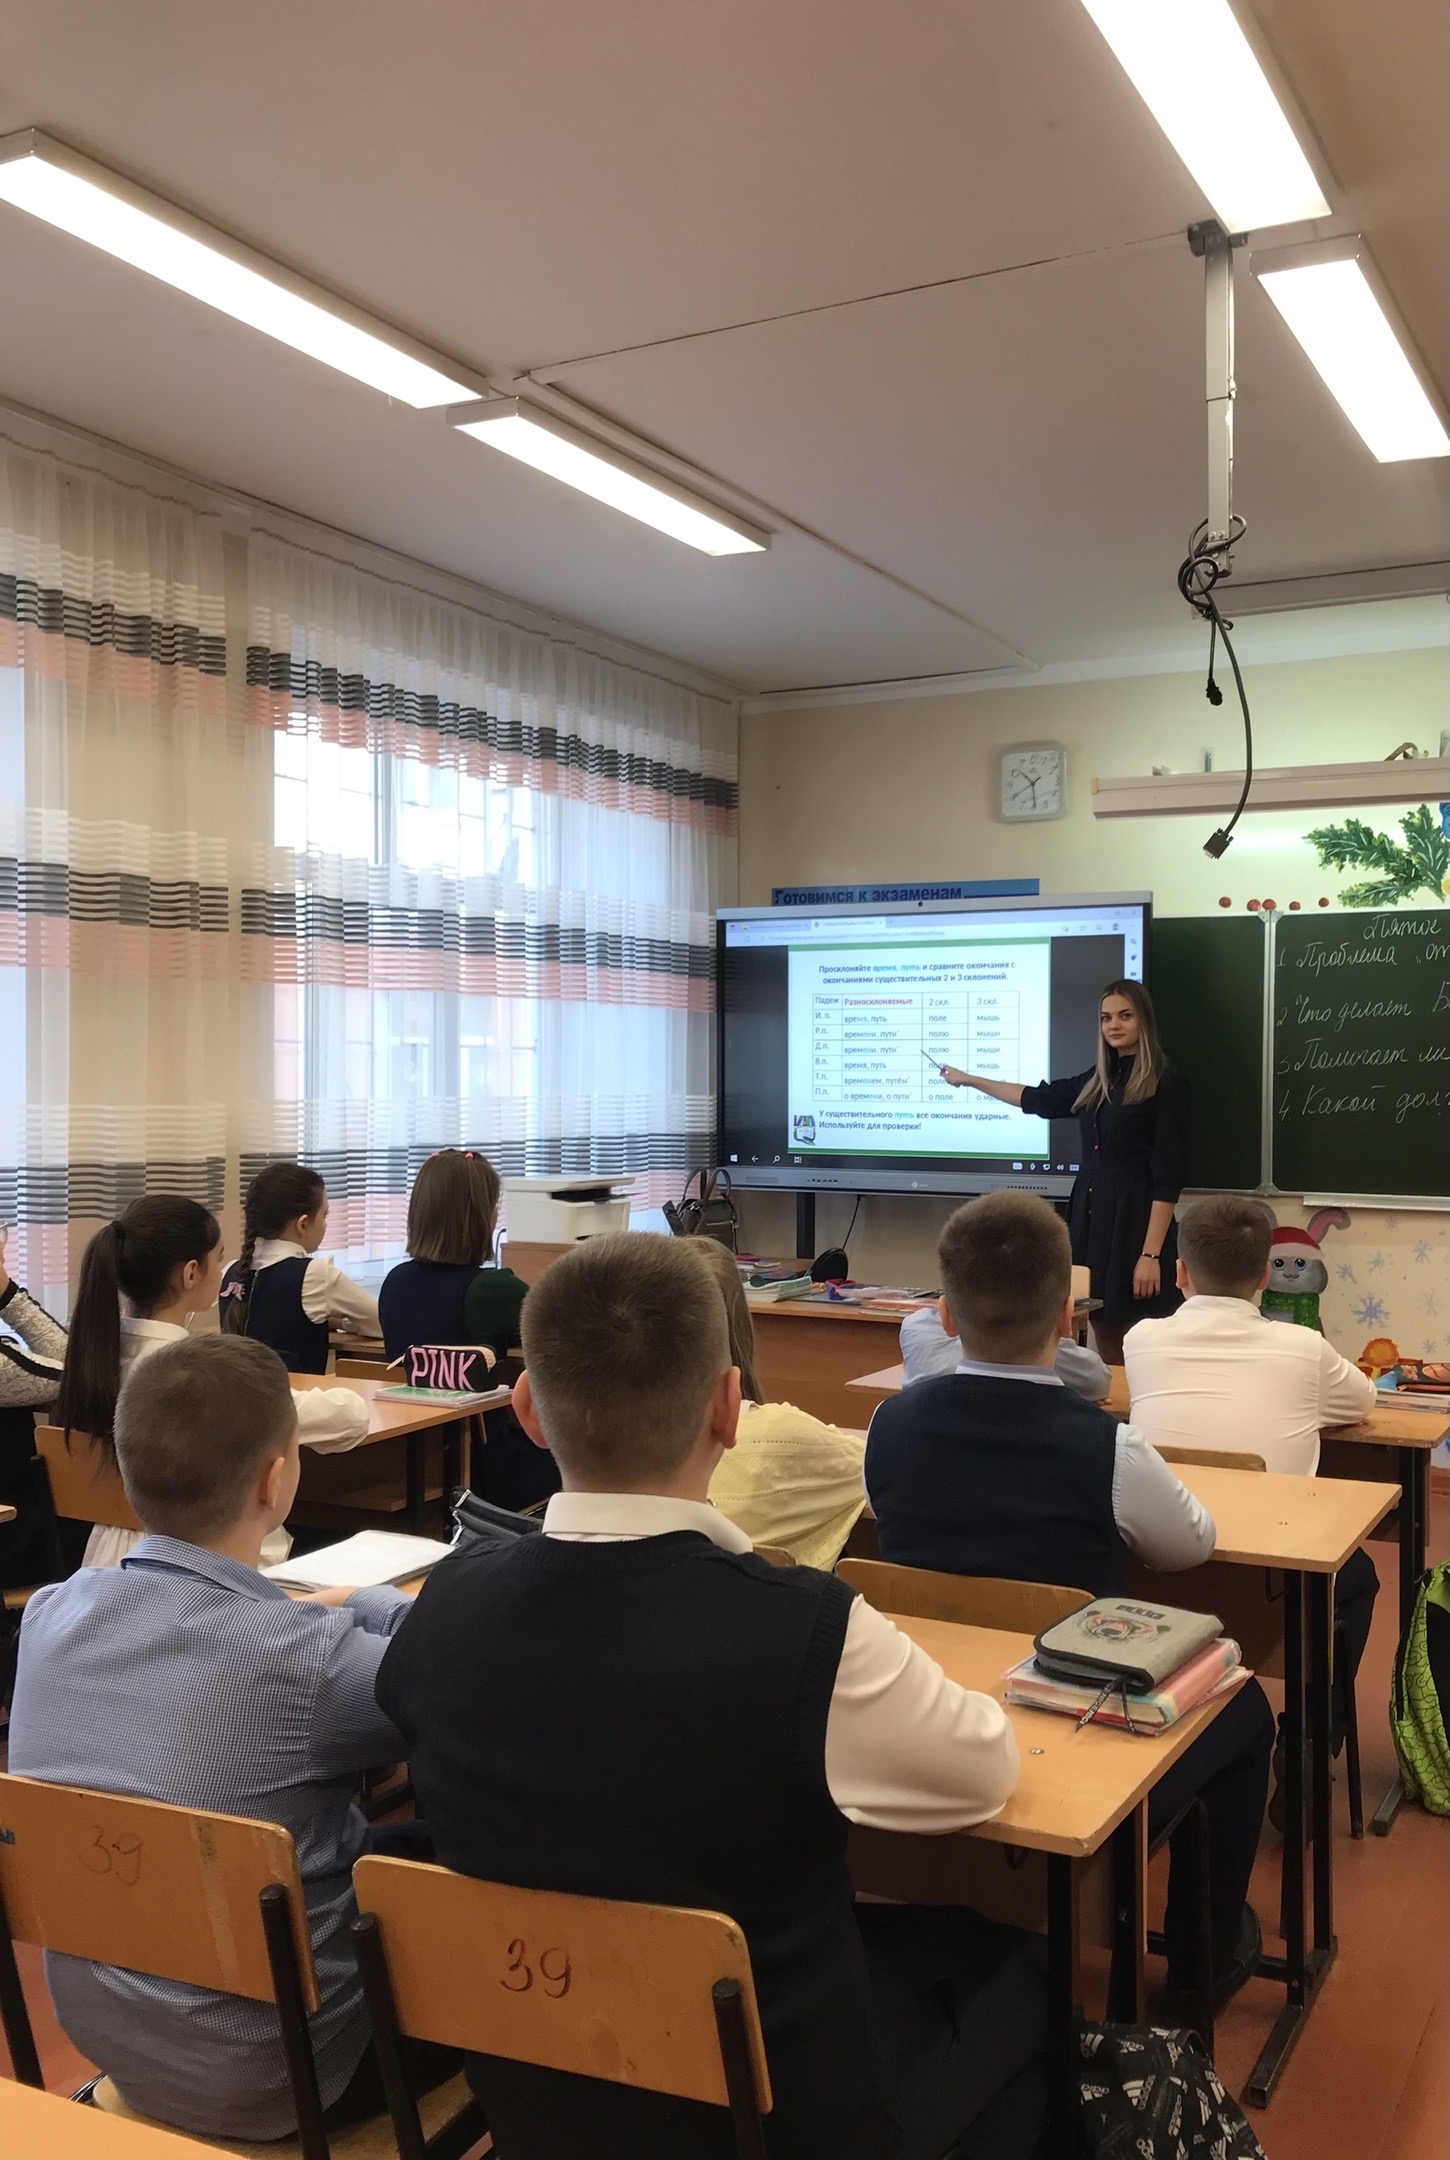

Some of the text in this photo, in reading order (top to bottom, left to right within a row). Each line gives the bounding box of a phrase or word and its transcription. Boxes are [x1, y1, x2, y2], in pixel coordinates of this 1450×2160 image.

[774, 887, 962, 906] Готовимся к экзаменам
[1296, 941, 1399, 978] Проблема
[819, 964, 872, 974] Просклоняйте
[873, 964, 899, 974] время,
[901, 964, 921, 973] путь
[929, 963, 965, 972] сравните
[966, 962, 1010, 970] окончания
[822, 976, 873, 985] окончаниями
[874, 975, 942, 985] существительных
[944, 974, 949, 982] 2
[957, 973, 963, 981] 3
[964, 972, 1009, 982] склонений.
[815, 996, 840, 1006] Падеж
[844, 998, 914, 1006] Разносклоняемые
[929, 998, 934, 1006] 2
[977, 997, 982, 1006] 3
[871, 1015, 888, 1024] путь
[1276, 1006, 1288, 1027] 2
[1295, 994, 1332, 1025] Что
[1334, 1000, 1412, 1033] делает
[1294, 1037, 1408, 1071] Помогает
[871, 1062, 888, 1070] путь
[935, 1093, 954, 1101] поле
[1301, 1084, 1387, 1116] Какой
[818, 1110, 825, 1119] У
[825, 1111, 893, 1120] существительного
[894, 1112, 914, 1120] путь
[930, 1112, 973, 1120] окончания
[974, 1113, 1012, 1122] ударные.
[818, 1121, 922, 1131] Используйте для проверки!
[411, 1347, 477, 1392] PINK
[77, 1823, 144, 1887] 39
[499, 1938, 572, 1999] 39
